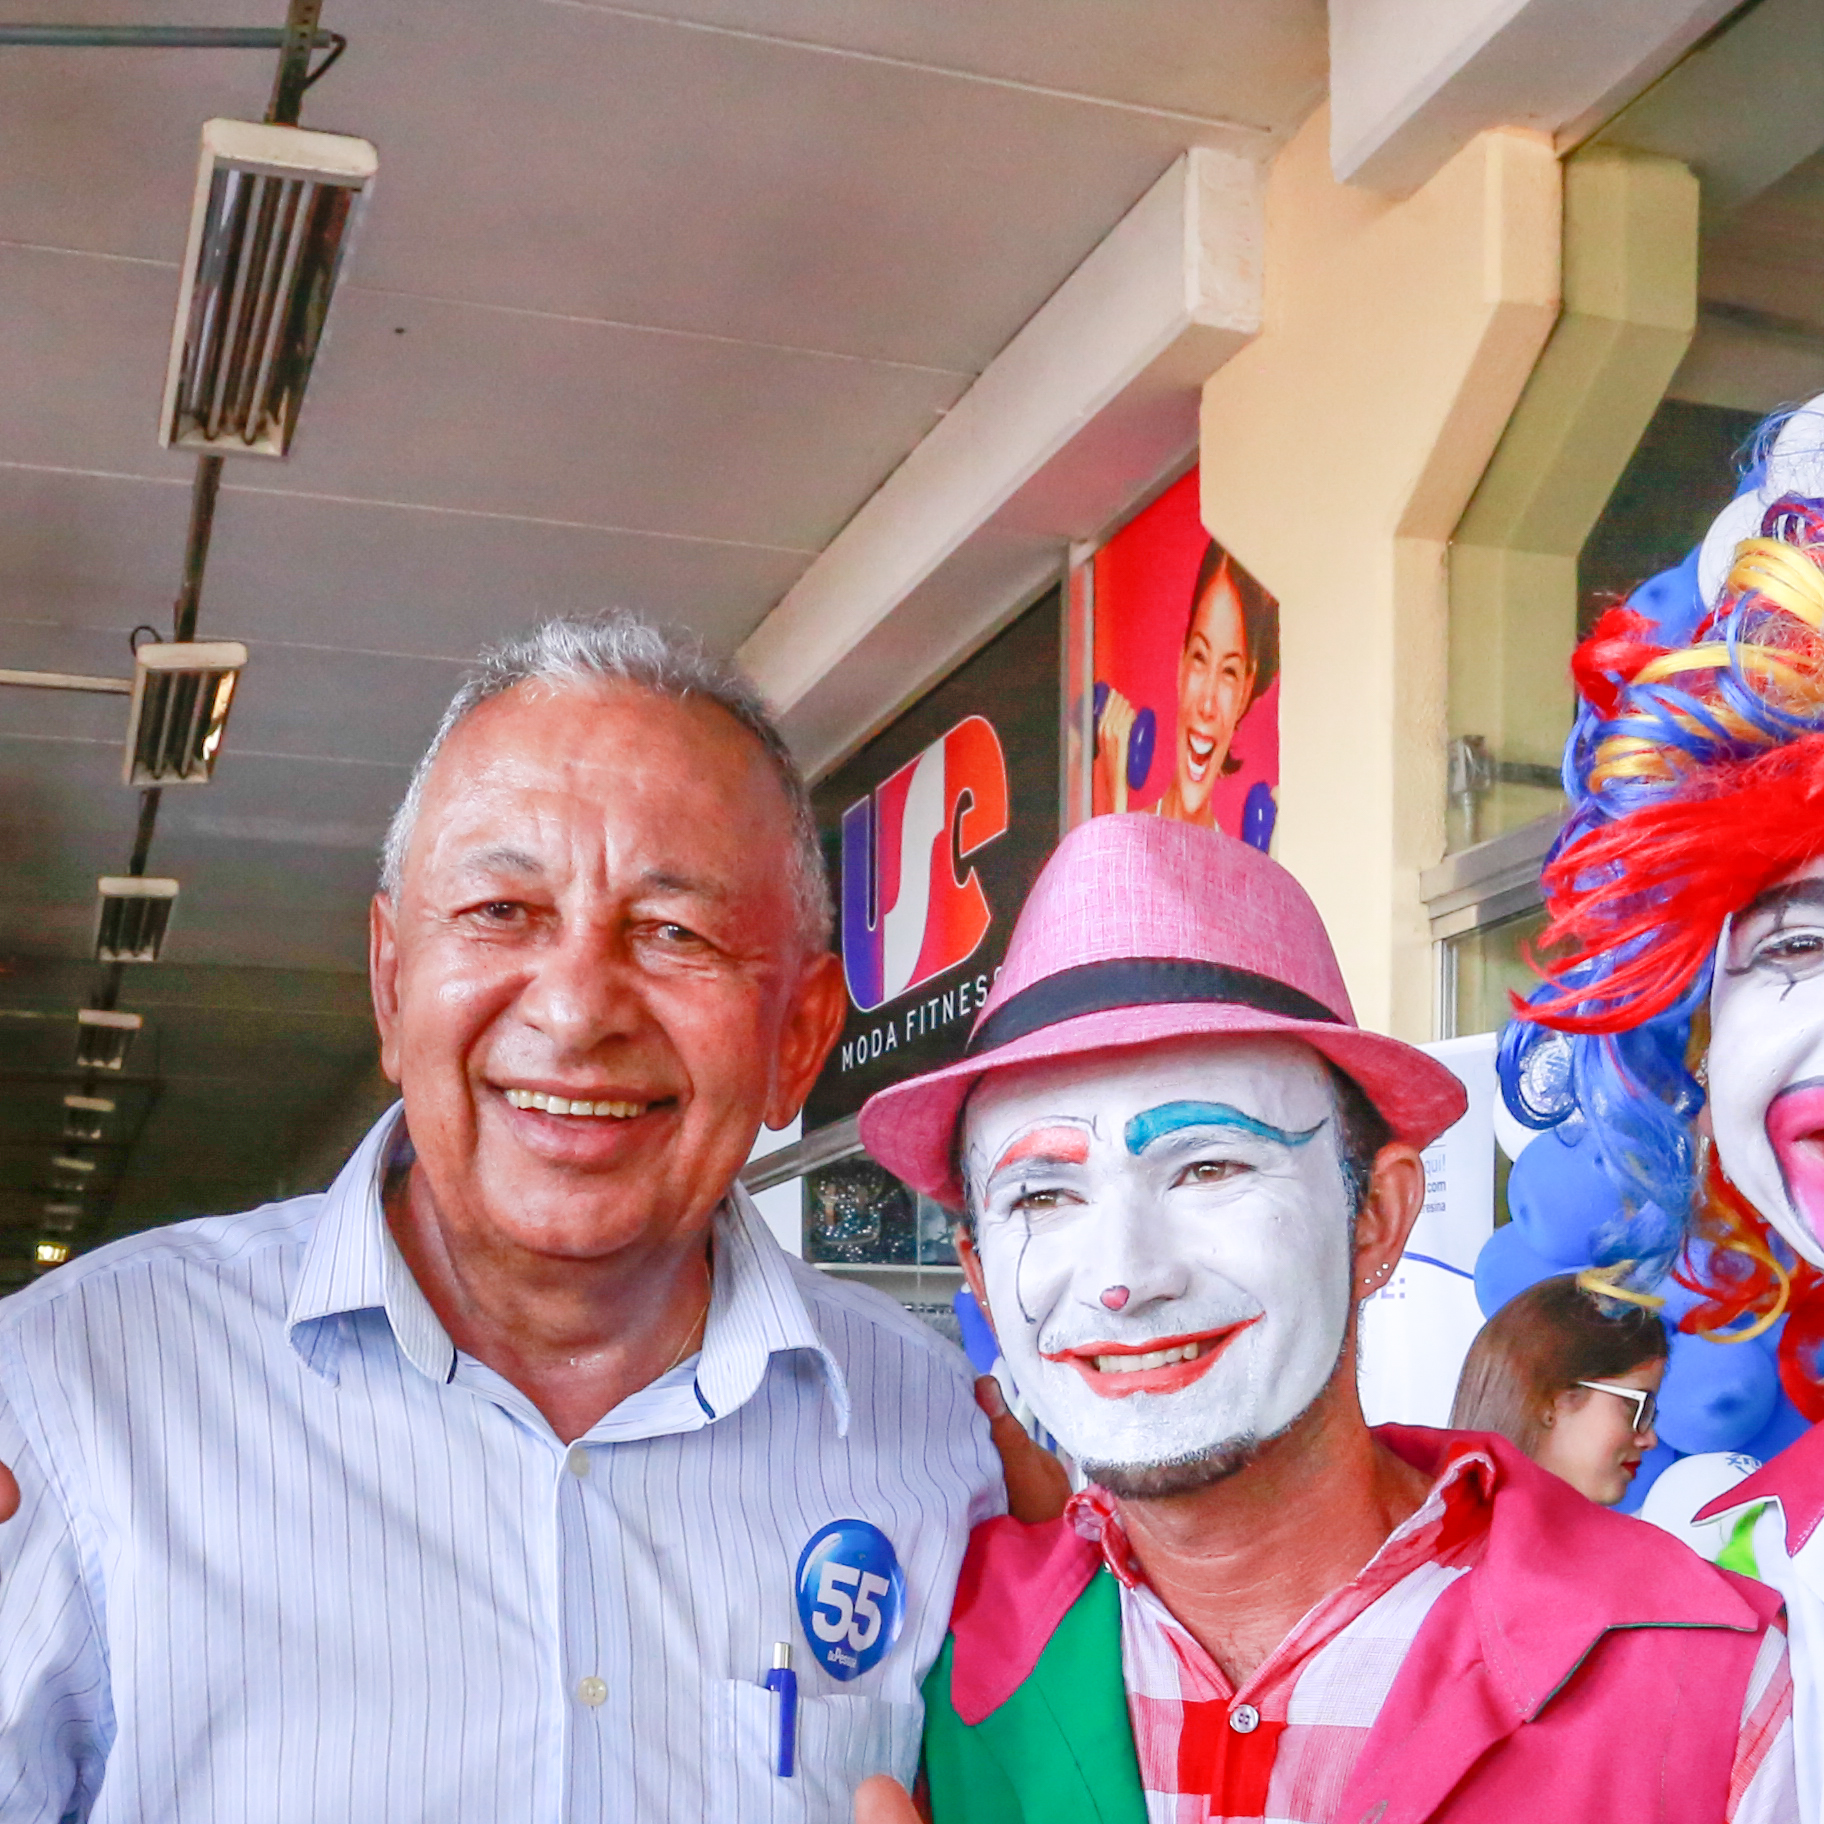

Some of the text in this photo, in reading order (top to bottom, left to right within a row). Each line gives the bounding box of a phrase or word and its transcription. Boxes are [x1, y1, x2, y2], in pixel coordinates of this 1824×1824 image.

[842, 966, 1004, 1072] MODA FITNES
[812, 1561, 890, 1652] 55
